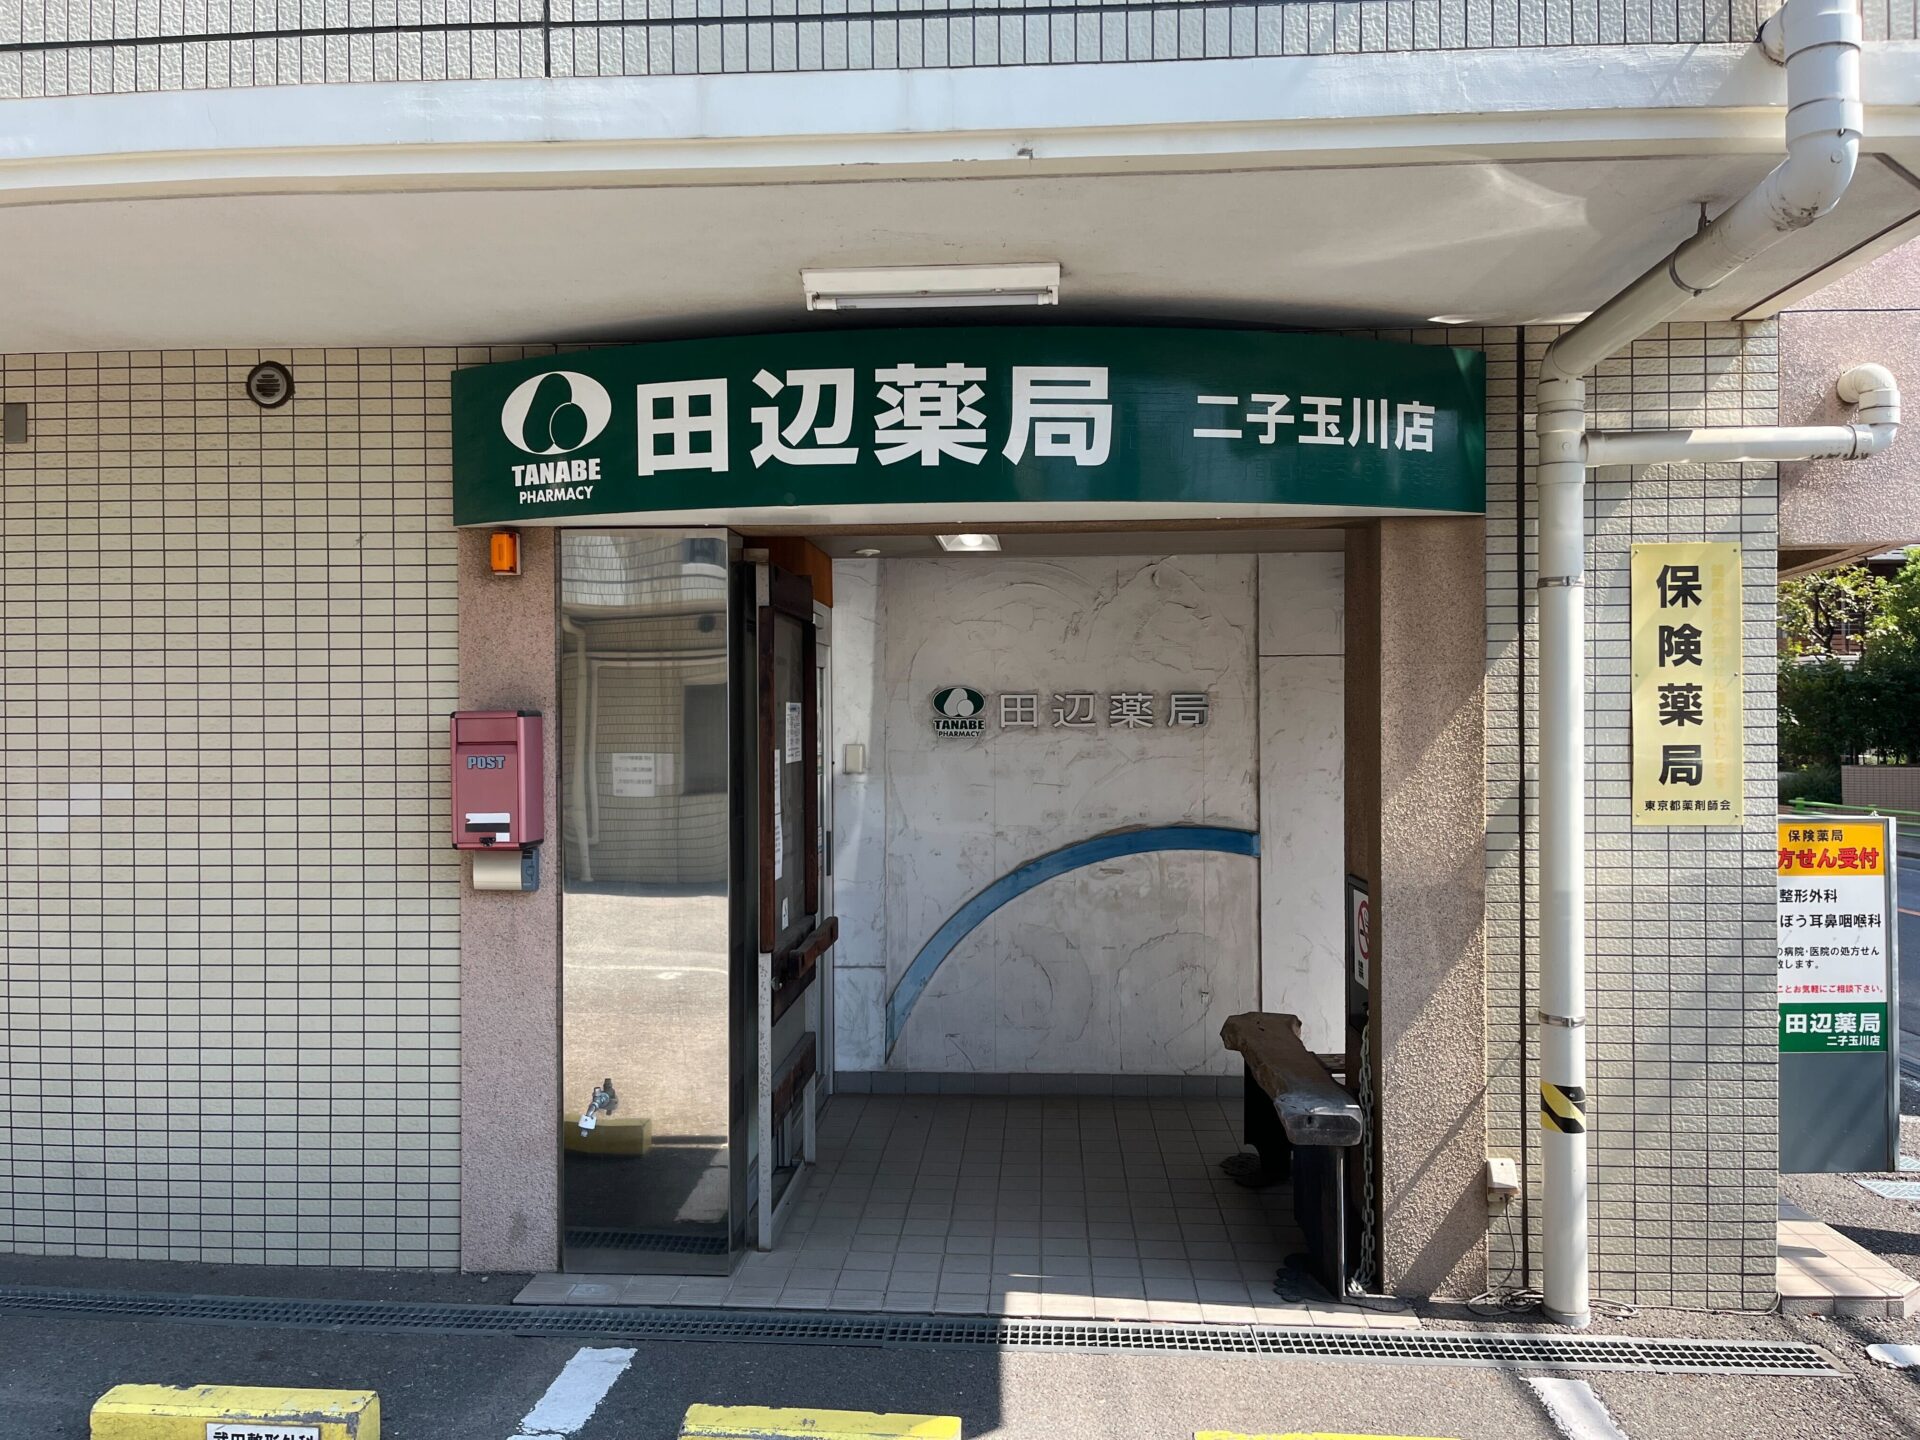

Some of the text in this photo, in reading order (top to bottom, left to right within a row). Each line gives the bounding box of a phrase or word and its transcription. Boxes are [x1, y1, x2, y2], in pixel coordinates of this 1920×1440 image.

[636, 363, 1435, 476] 田辺薬局 二子玉川店
[511, 458, 602, 487] TANABE
[519, 485, 594, 505] PHARMACY
[1656, 564, 1703, 786] 保険薬局
[1000, 692, 1211, 729] 田辺薬局
[934, 718, 985, 731] TANABE
[938, 730, 980, 738] PHARMACY
[467, 756, 505, 769] POST
[1644, 800, 1731, 812] 東京都薬剤師会
[1788, 829, 1843, 842] 保険薬局
[1778, 847, 1879, 869] 方せん受付
[1779, 889, 1838, 903] 整形外科
[1785, 1012, 1881, 1034] 田辺薬局
[1826, 1035, 1881, 1047] 二子玉川店
